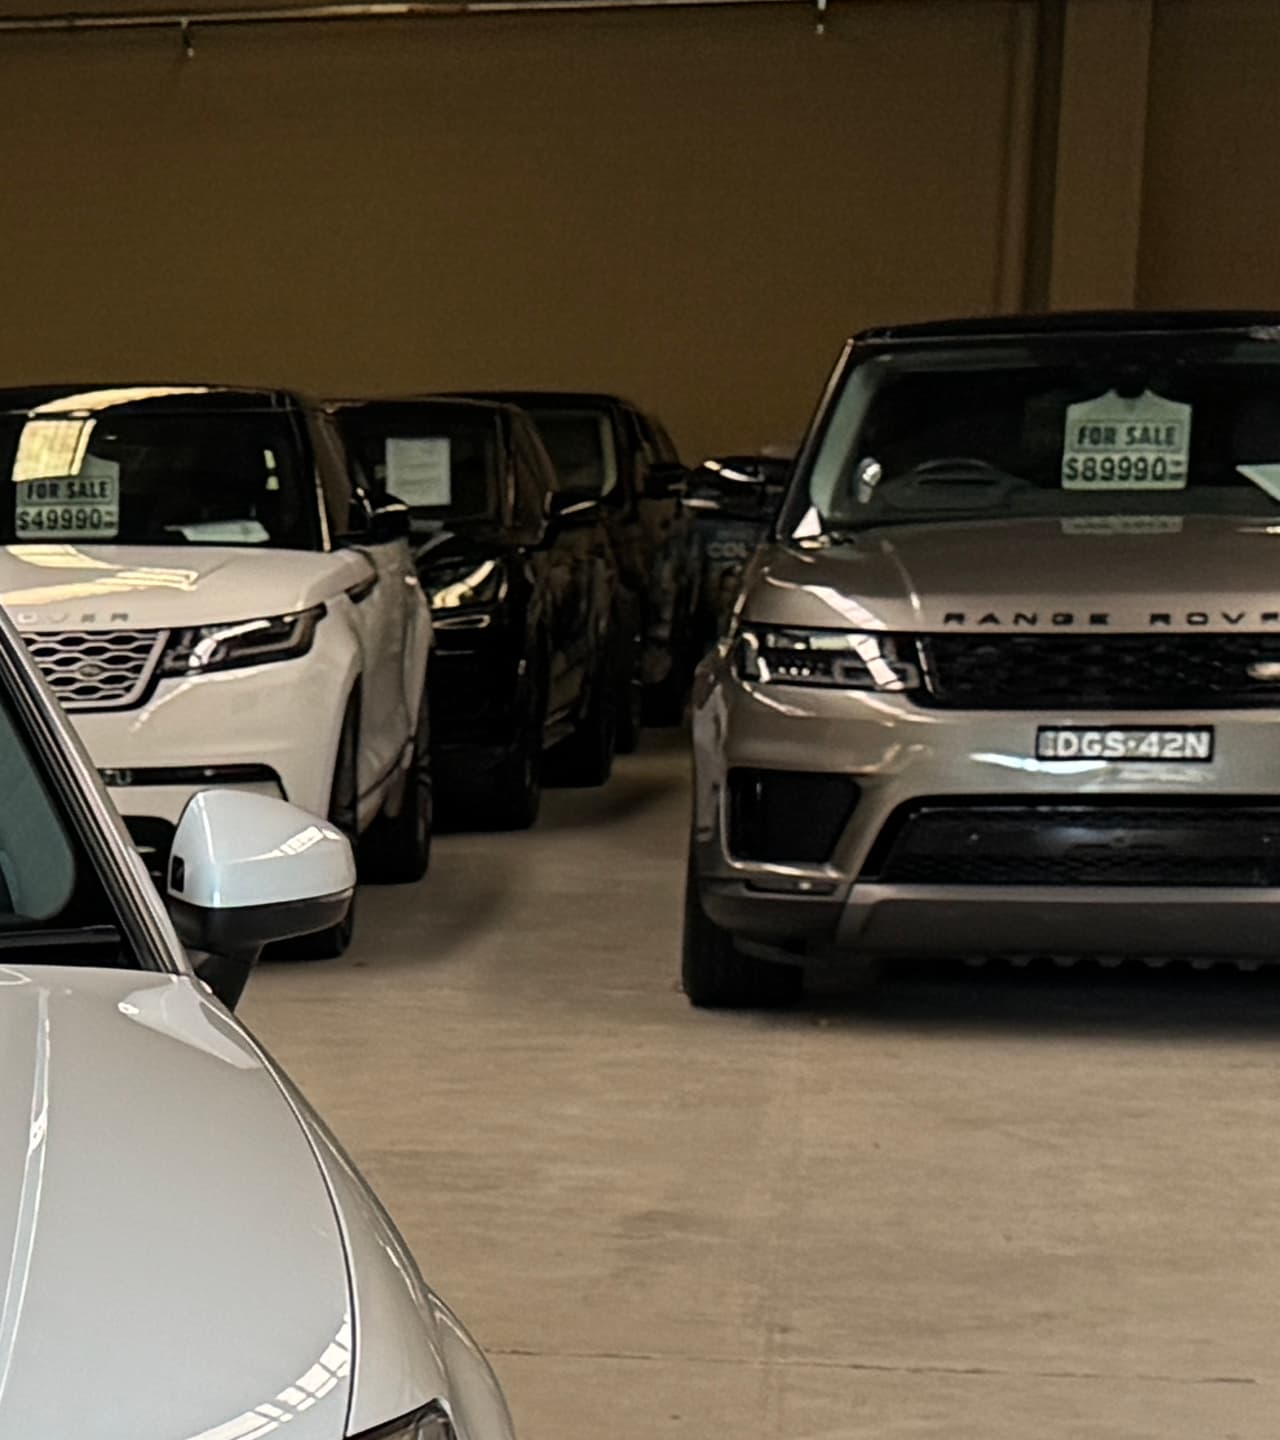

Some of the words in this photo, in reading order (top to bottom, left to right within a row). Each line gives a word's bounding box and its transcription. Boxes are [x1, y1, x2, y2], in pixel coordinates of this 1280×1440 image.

[1078, 425, 1117, 446] FOR
[1125, 426, 1175, 446] SALE
[27, 482, 59, 499] FOR
[66, 481, 109, 499] SALE
[944, 611, 1110, 626] RANGE
